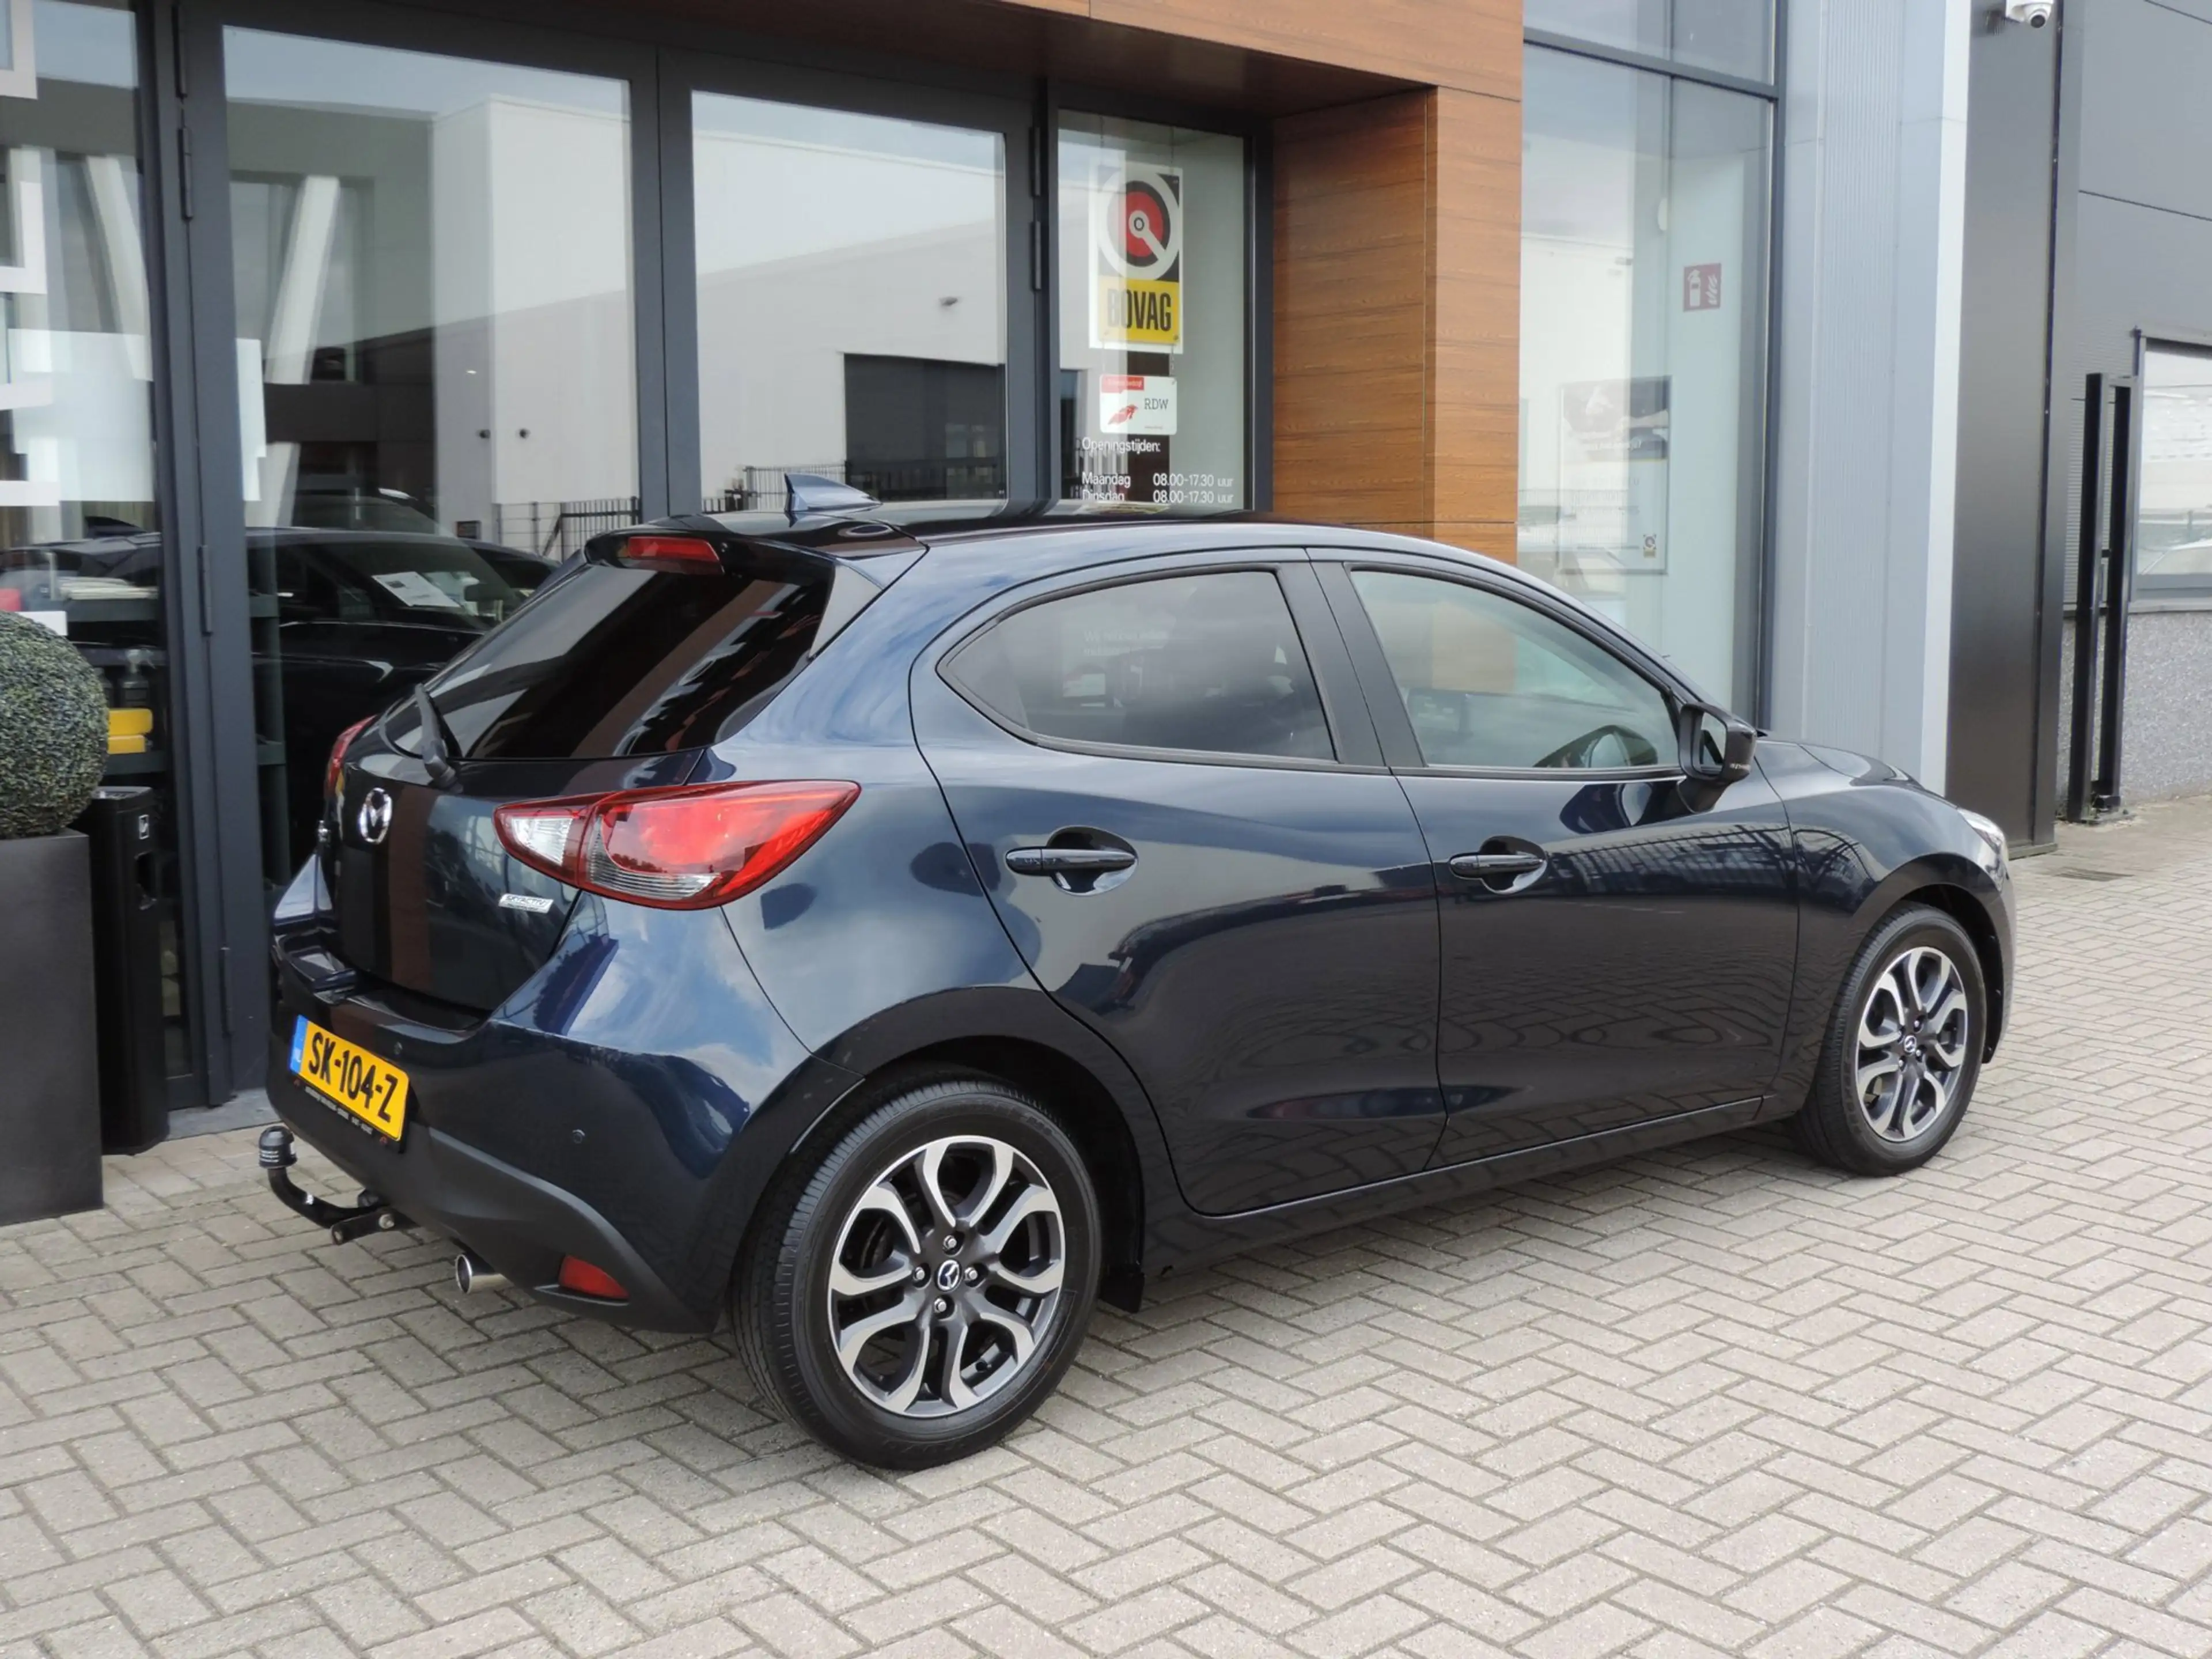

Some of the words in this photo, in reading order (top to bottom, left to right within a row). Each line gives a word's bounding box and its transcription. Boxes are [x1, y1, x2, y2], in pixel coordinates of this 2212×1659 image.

[1107, 288, 1172, 332] BOVAG
[1144, 398, 1169, 410] RDW
[1082, 437, 1161, 455] Openingstijden:
[1082, 472, 1131, 488] Maandag
[1153, 472, 1214, 487] 08.00-17.30
[1218, 478, 1234, 487] uur
[1153, 490, 1214, 503] 08.00-17.30
[1218, 493, 1234, 503] uur
[308, 1032, 399, 1123] SK-104-Z
